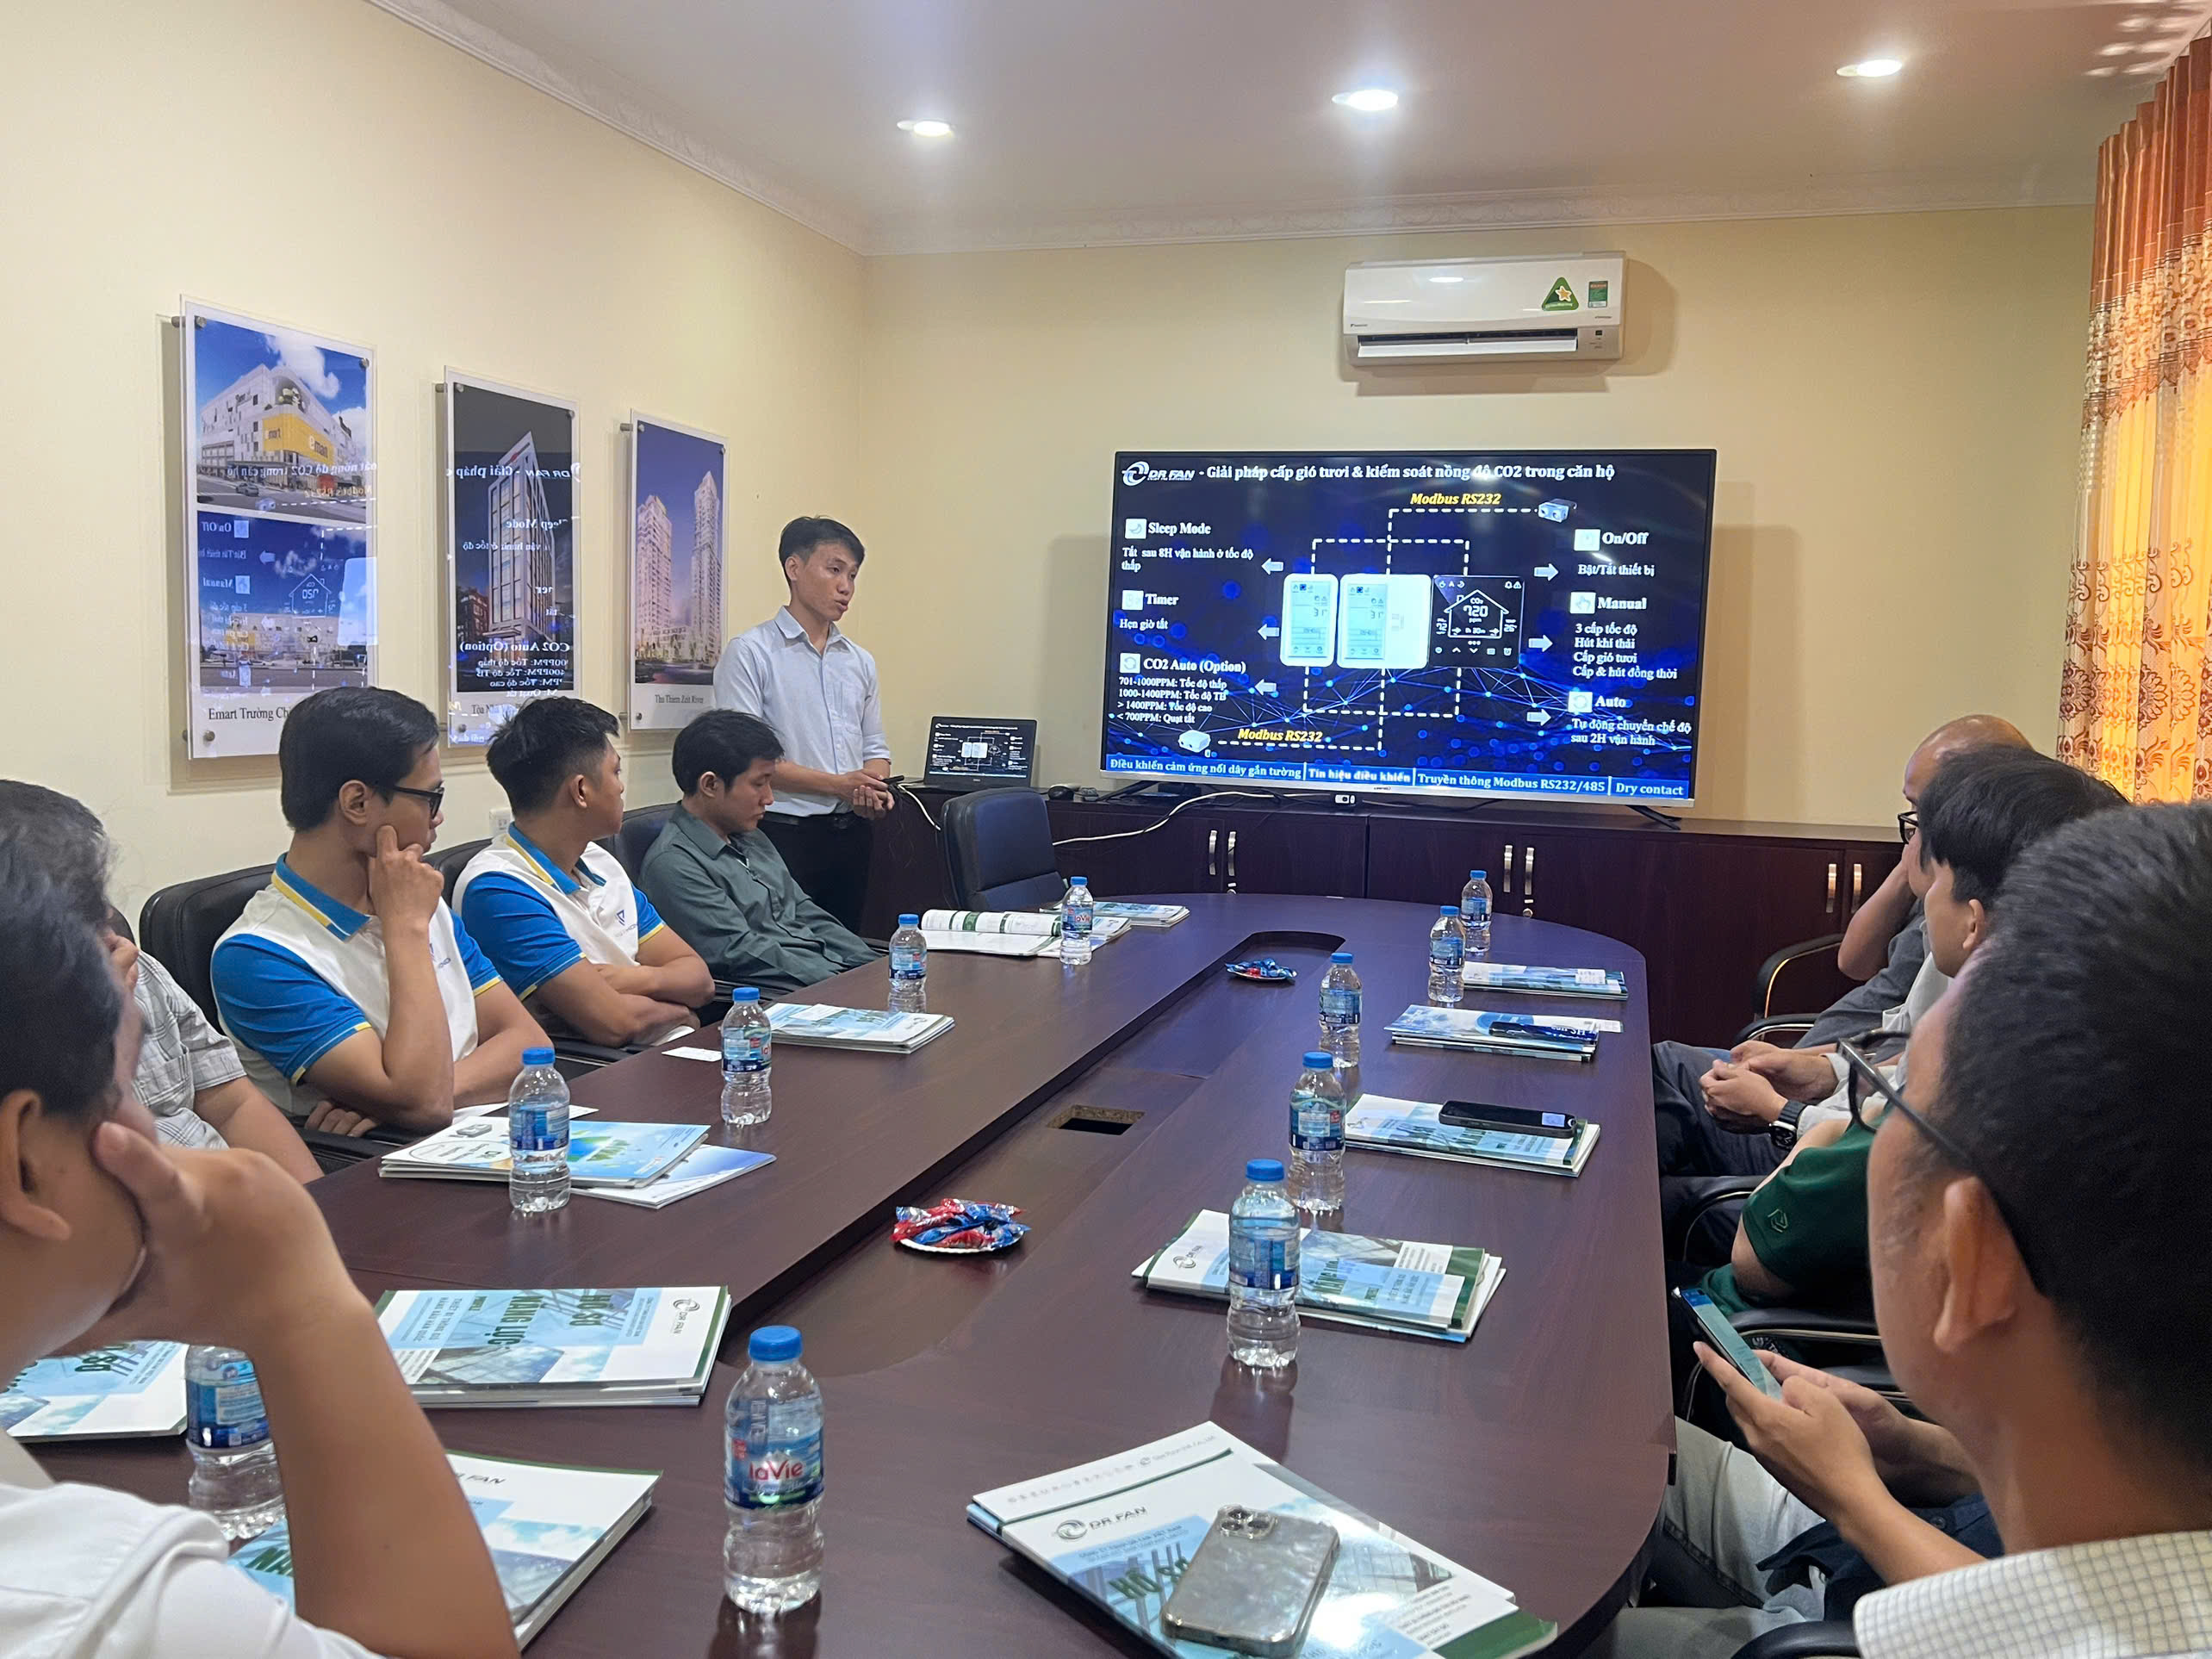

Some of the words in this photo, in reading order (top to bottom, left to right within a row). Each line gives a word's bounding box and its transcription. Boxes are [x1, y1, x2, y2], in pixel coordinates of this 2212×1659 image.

[1207, 465, 1233, 478] Giải
[1234, 466, 1268, 482] pháp
[1271, 465, 1293, 481] cấp
[1296, 465, 1317, 482] gió
[1320, 466, 1349, 478] tươi
[1351, 467, 1363, 478] &
[1365, 463, 1401, 478] kiểm
[1403, 465, 1432, 478] soát
[1435, 464, 1470, 481] nồng
[1494, 466, 1522, 478] CO2
[1525, 467, 1564, 481] trong
[1567, 465, 1593, 478] căn
[1595, 465, 1615, 481] hộ
[1410, 493, 1459, 505] Modbus
[1461, 493, 1501, 505] RS232
[1148, 523, 1177, 536] Sleep
[1179, 523, 1211, 534] Mode
[1602, 532, 1650, 544] On/Off
[1159, 548, 1172, 558] 8H
[1241, 549, 1253, 561] độ
[1619, 562, 1642, 575] thiết
[1644, 565, 1656, 577] bị
[1146, 593, 1179, 605] Timer
[1598, 597, 1647, 609] Manual
[1463, 606, 1488, 617] 720
[1120, 618, 1138, 630] Hẹn
[1140, 618, 1155, 631] giờ
[1575, 624, 1582, 633] 3
[1584, 621, 1603, 637] cấp
[1605, 621, 1621, 635] tốc
[1623, 624, 1637, 636] độ
[1575, 637, 1594, 648] Hút
[1596, 637, 1613, 649] khí
[1573, 649, 1594, 664] Cấp
[1596, 652, 1613, 664] gió
[1615, 653, 1637, 663] tươi
[1144, 658, 1168, 670] CO2
[1170, 659, 1196, 671] Auto
[1199, 661, 1246, 674] (Option)
[1573, 664, 1594, 679] Cấp
[1595, 667, 1606, 677] &
[1608, 667, 1625, 677] hút
[1627, 665, 1654, 680] đồng
[1656, 668, 1678, 679] thời
[1119, 677, 1177, 687] 701-1000PPM:
[1179, 676, 1196, 688] Tốc
[1196, 679, 1208, 689] độ
[1119, 689, 1182, 699] 1000-1400PPM:
[1184, 689, 1200, 700] Tốc
[1201, 691, 1213, 702] độ
[1594, 695, 1627, 708] Auto
[1126, 701, 1166, 711] 1400PPM:
[1186, 703, 1196, 712] độ
[208, 708, 237, 720] Emart
[239, 707, 274, 721] Trường
[1125, 712, 1161, 722] 700PPM:
[1163, 714, 1183, 724] Quạt
[1571, 718, 1588, 730] Tự
[1589, 718, 1615, 732] động
[1617, 718, 1654, 733] chuyển
[1656, 719, 1675, 732] chế
[1677, 722, 1692, 734] độ
[1238, 729, 1283, 742] Modbus
[1284, 730, 1323, 743] RS232
[1590, 733, 1606, 743] 2H
[1630, 734, 1656, 745] hành
[1110, 757, 1134, 770] Điều
[1135, 758, 1163, 771] khiển
[1165, 761, 1186, 773] cảm
[1188, 760, 1209, 774] ứng
[1210, 761, 1227, 774] nối
[1228, 762, 1246, 777] dây
[1249, 763, 1266, 777] gắn
[1269, 764, 1302, 779] tường
[1308, 768, 1326, 779] Tín
[1328, 768, 1351, 782] hiệu
[1353, 768, 1376, 780] điều
[1379, 768, 1410, 782] khiển
[1417, 773, 1457, 787] Truyền
[1459, 774, 1491, 789] thông
[1494, 776, 1538, 789] Modbus
[1541, 780, 1605, 792] RS232/485
[1616, 782, 1637, 796] Dry
[1640, 785, 1683, 796] contact
[466, 1474, 506, 1484] FAN
[1089, 1517, 1112, 1531] DR
[1115, 1506, 1148, 1521] FAN
